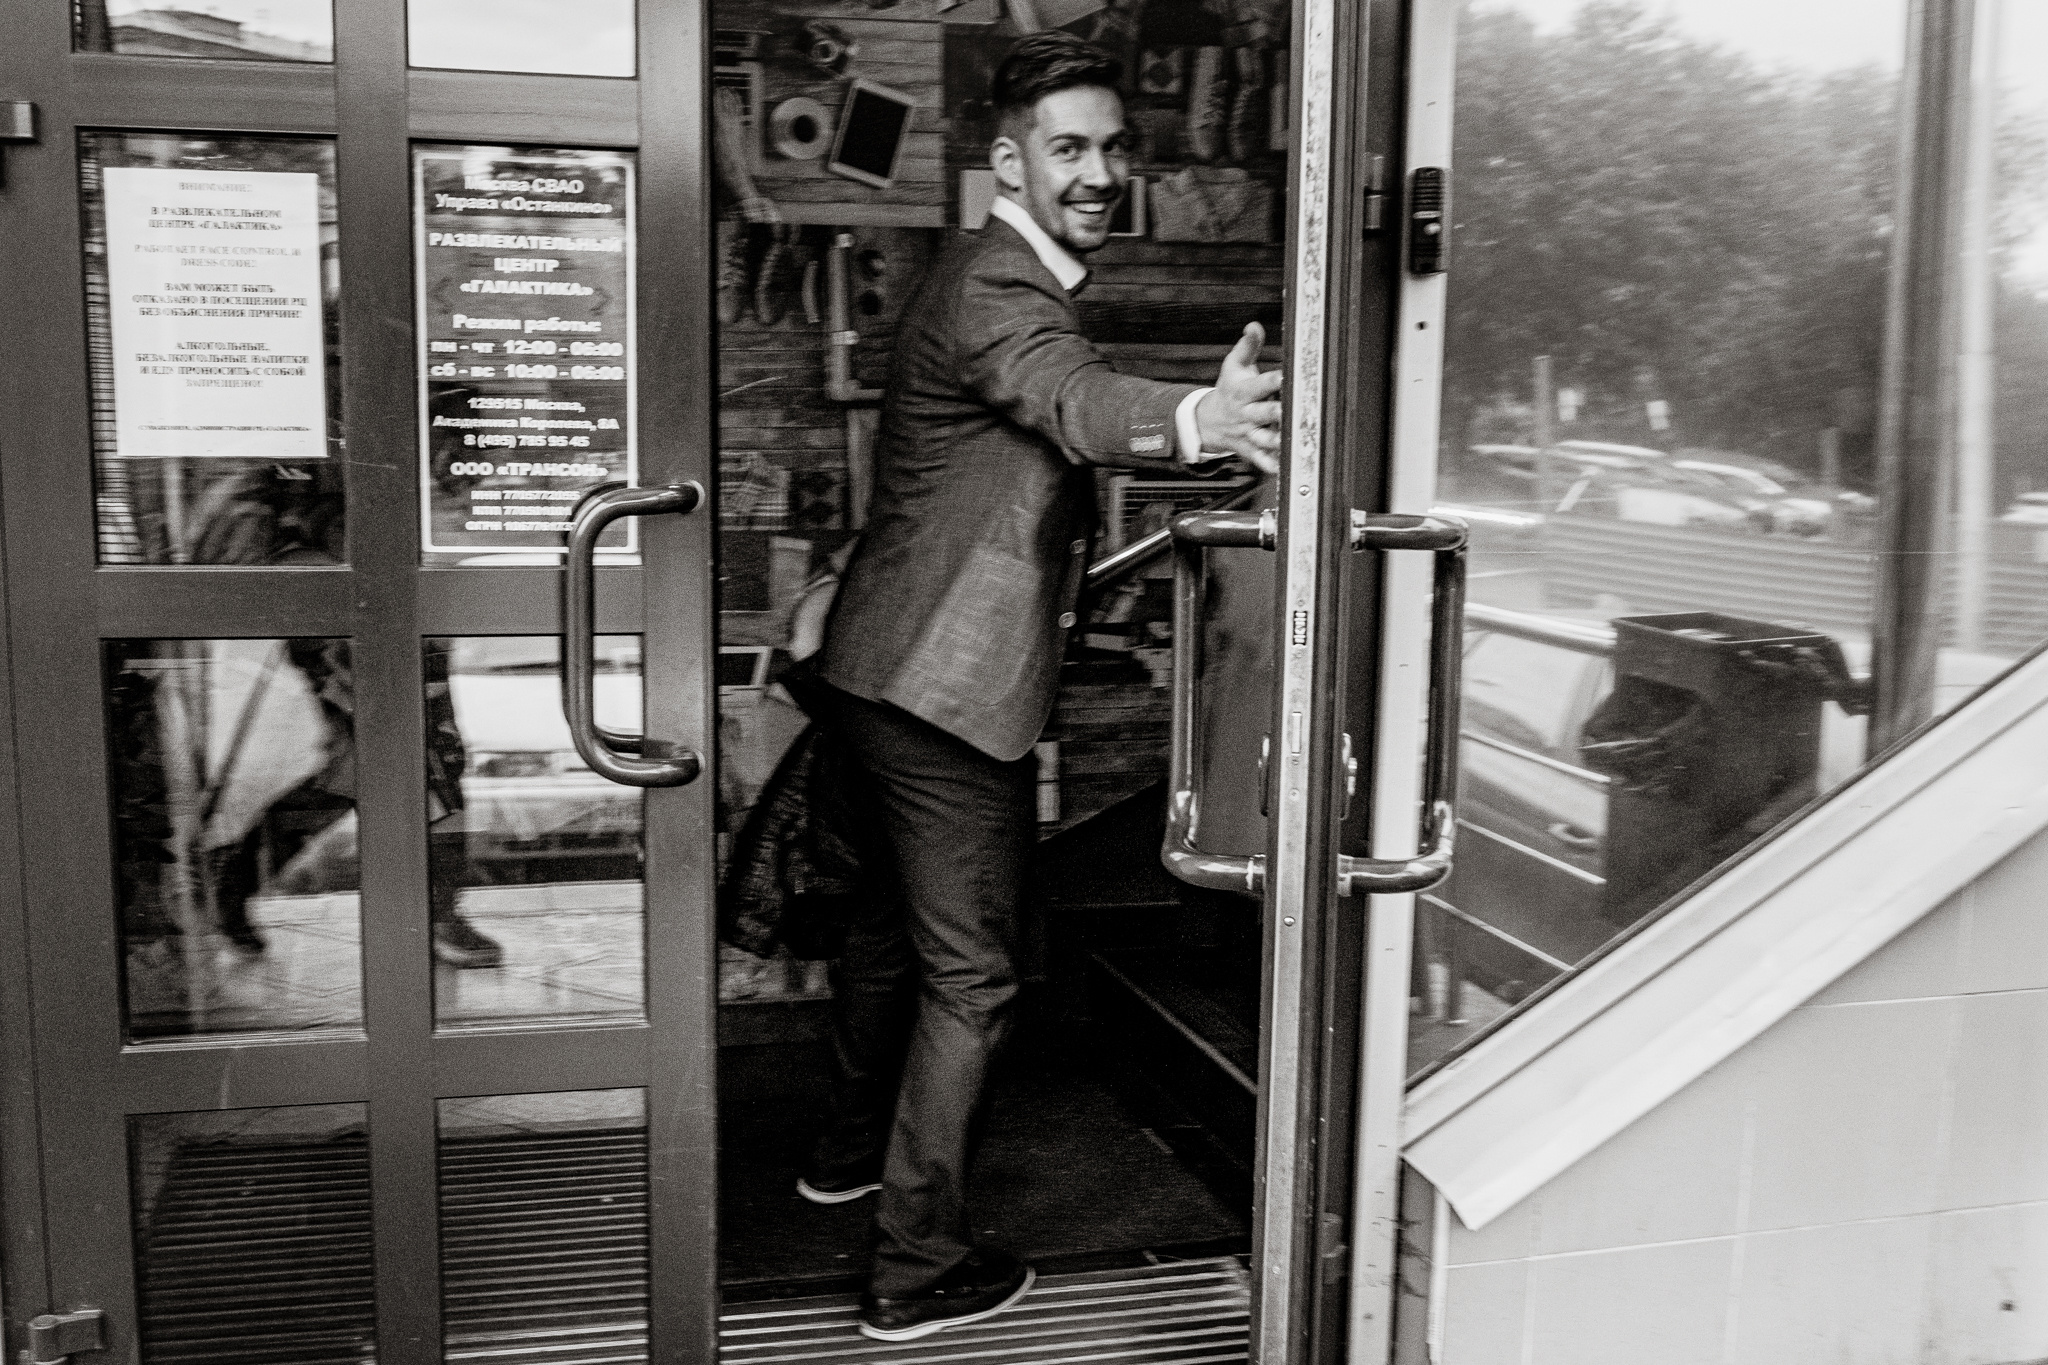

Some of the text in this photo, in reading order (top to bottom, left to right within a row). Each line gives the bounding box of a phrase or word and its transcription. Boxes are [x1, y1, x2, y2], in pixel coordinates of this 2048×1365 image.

[465, 175, 585, 194] Москва СВАО
[435, 194, 499, 212] Управа
[151, 206, 282, 218] В РАЗВЛЕКАТЕЛЬНОМ
[149, 219, 195, 229] ЦЕНТРЕ
[429, 232, 623, 252] РАЗВЛЕКАТЕЛЬНЫЙ
[494, 257, 560, 273] ЦЕНТР
[164, 282, 276, 293] ВАМ МОЖЕТ БЫТЬ
[460, 280, 594, 296] «ГАЛАКТИКА»
[131, 294, 198, 304] ОТКАЗАНО
[199, 295, 207, 304] В
[209, 296, 289, 306] ПОСЕЩЕНИИ
[139, 307, 161, 316] БЕЗ
[163, 307, 246, 317] ОБЪЯСНЕНИЯ
[453, 314, 522, 330] Режим
[503, 340, 557, 355] 12:00
[135, 353, 310, 364] БЕЗАЛКОГОЛЬНЫЕ НАПИТКИ
[139, 365, 150, 375] И
[177, 366, 251, 375] ПРОНОСИТЬ
[252, 367, 263, 375] С
[264, 365, 307, 376] СОБОЙ
[430, 363, 457, 377] сб
[524, 398, 586, 412] Москва,
[432, 415, 518, 429] Академика
[463, 434, 477, 446] 8
[450, 461, 495, 476] ООО
